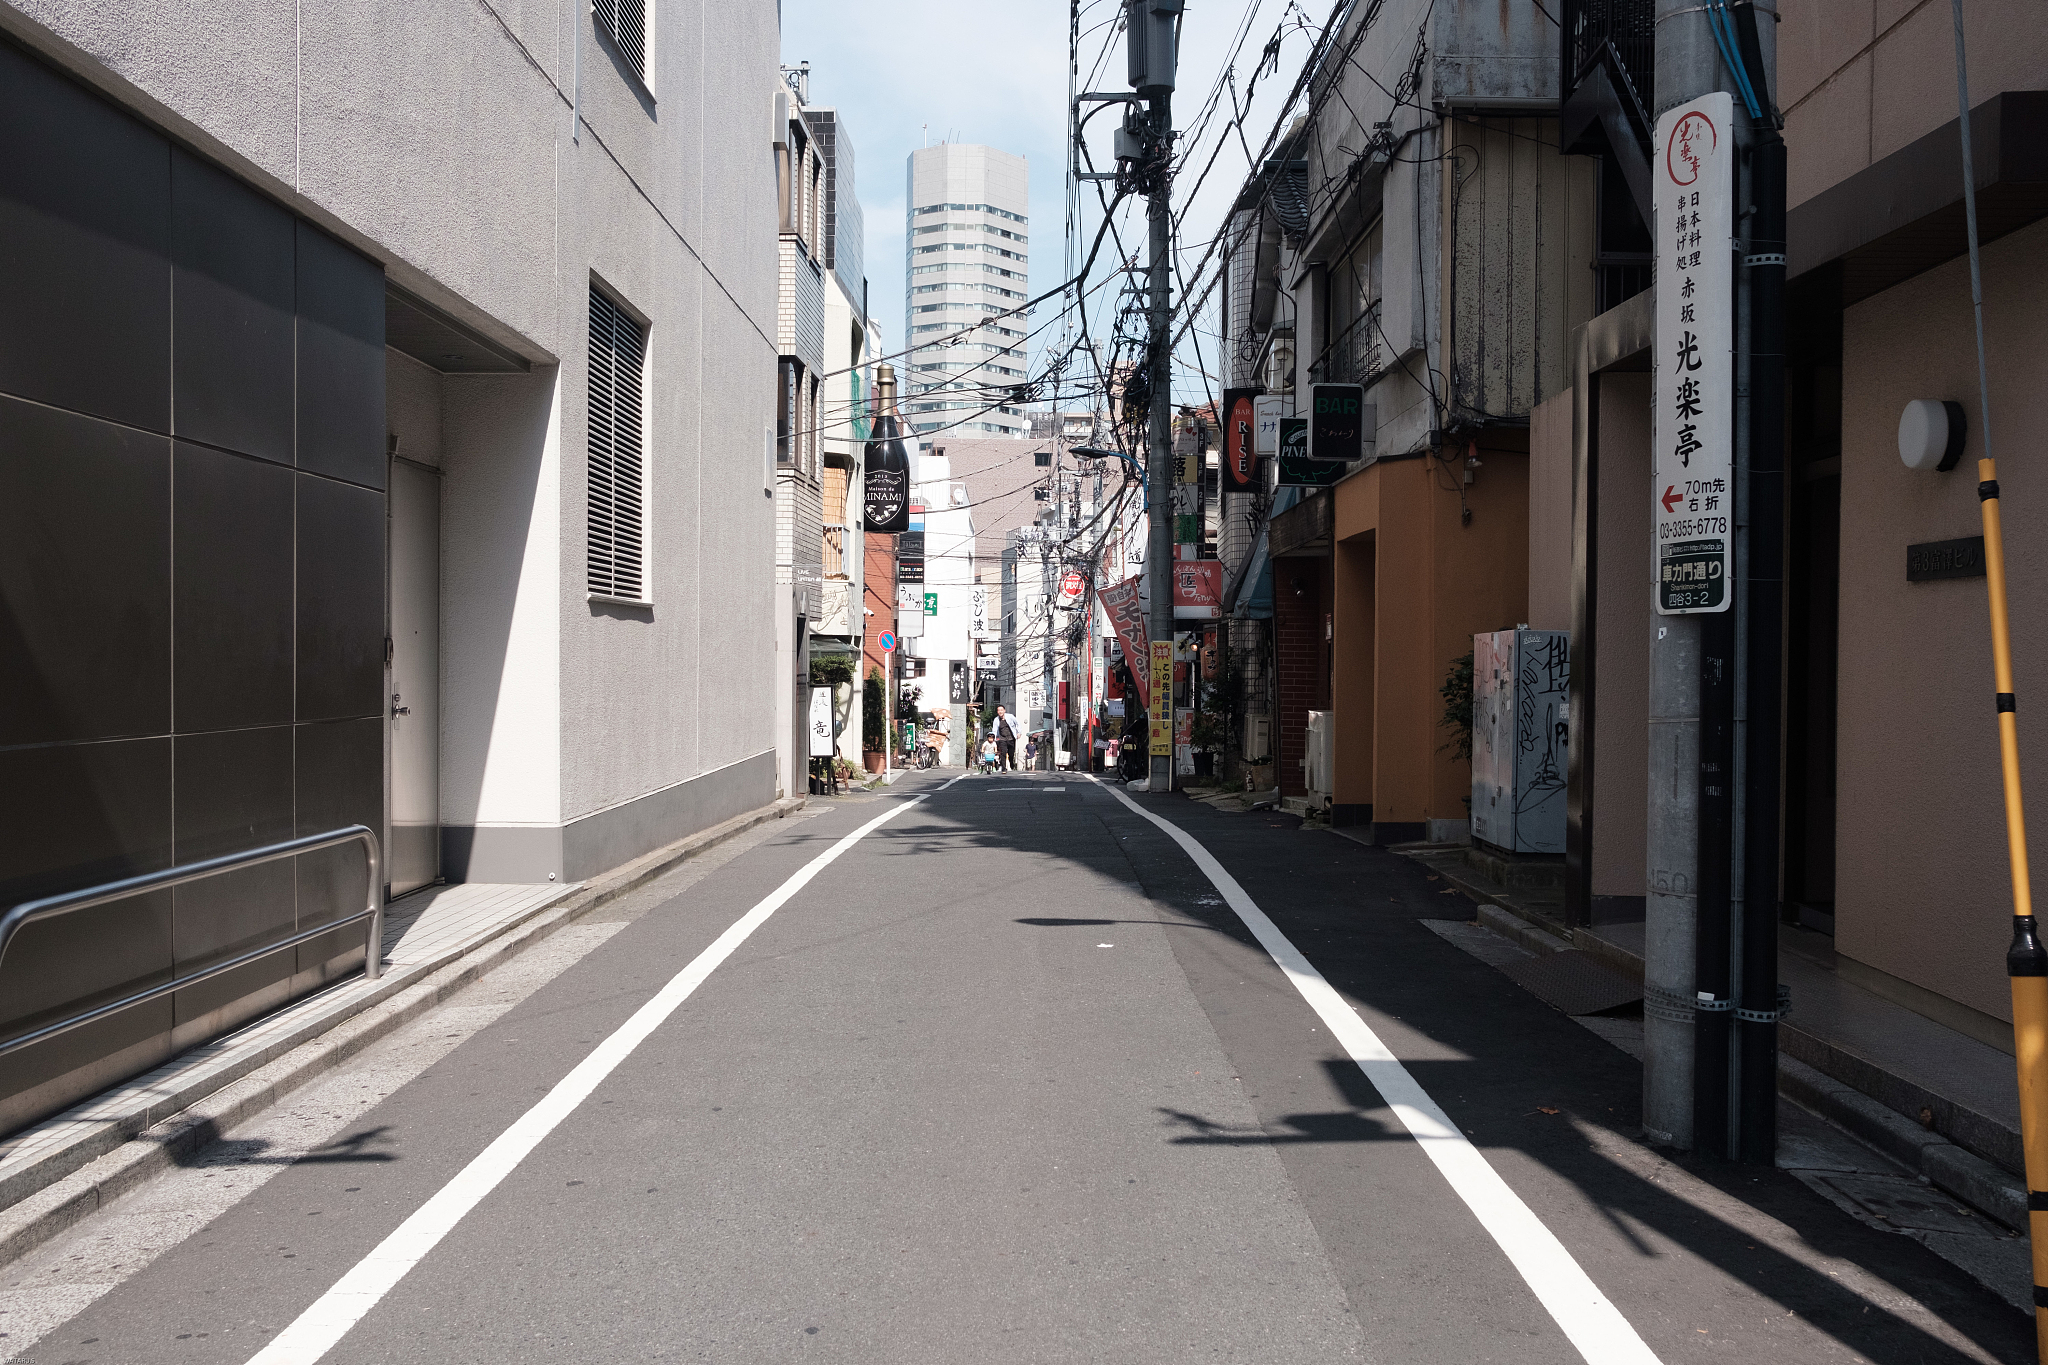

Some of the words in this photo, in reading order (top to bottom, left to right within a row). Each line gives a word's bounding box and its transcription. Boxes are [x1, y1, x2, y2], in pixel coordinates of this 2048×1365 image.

[1675, 195, 1688, 273] 串揚げ処
[1688, 191, 1702, 268] 日本料理
[1680, 276, 1695, 325] 赤坂
[1315, 397, 1359, 415] BAR
[1674, 330, 1704, 469] 光楽亭
[1235, 408, 1251, 416] BAR
[1238, 420, 1249, 473] RISE
[1281, 445, 1306, 458] PINE
[865, 492, 902, 501] MINAMI
[1685, 478, 1725, 495] 70m先
[1660, 516, 1727, 540] 03-3355-6778
[1662, 560, 1722, 583] 車力門通り
[1912, 547, 1978, 573] 第3富澤ビル
[1156, 648, 1169, 657] 注意
[1162, 663, 1170, 730] この先幅員狭し
